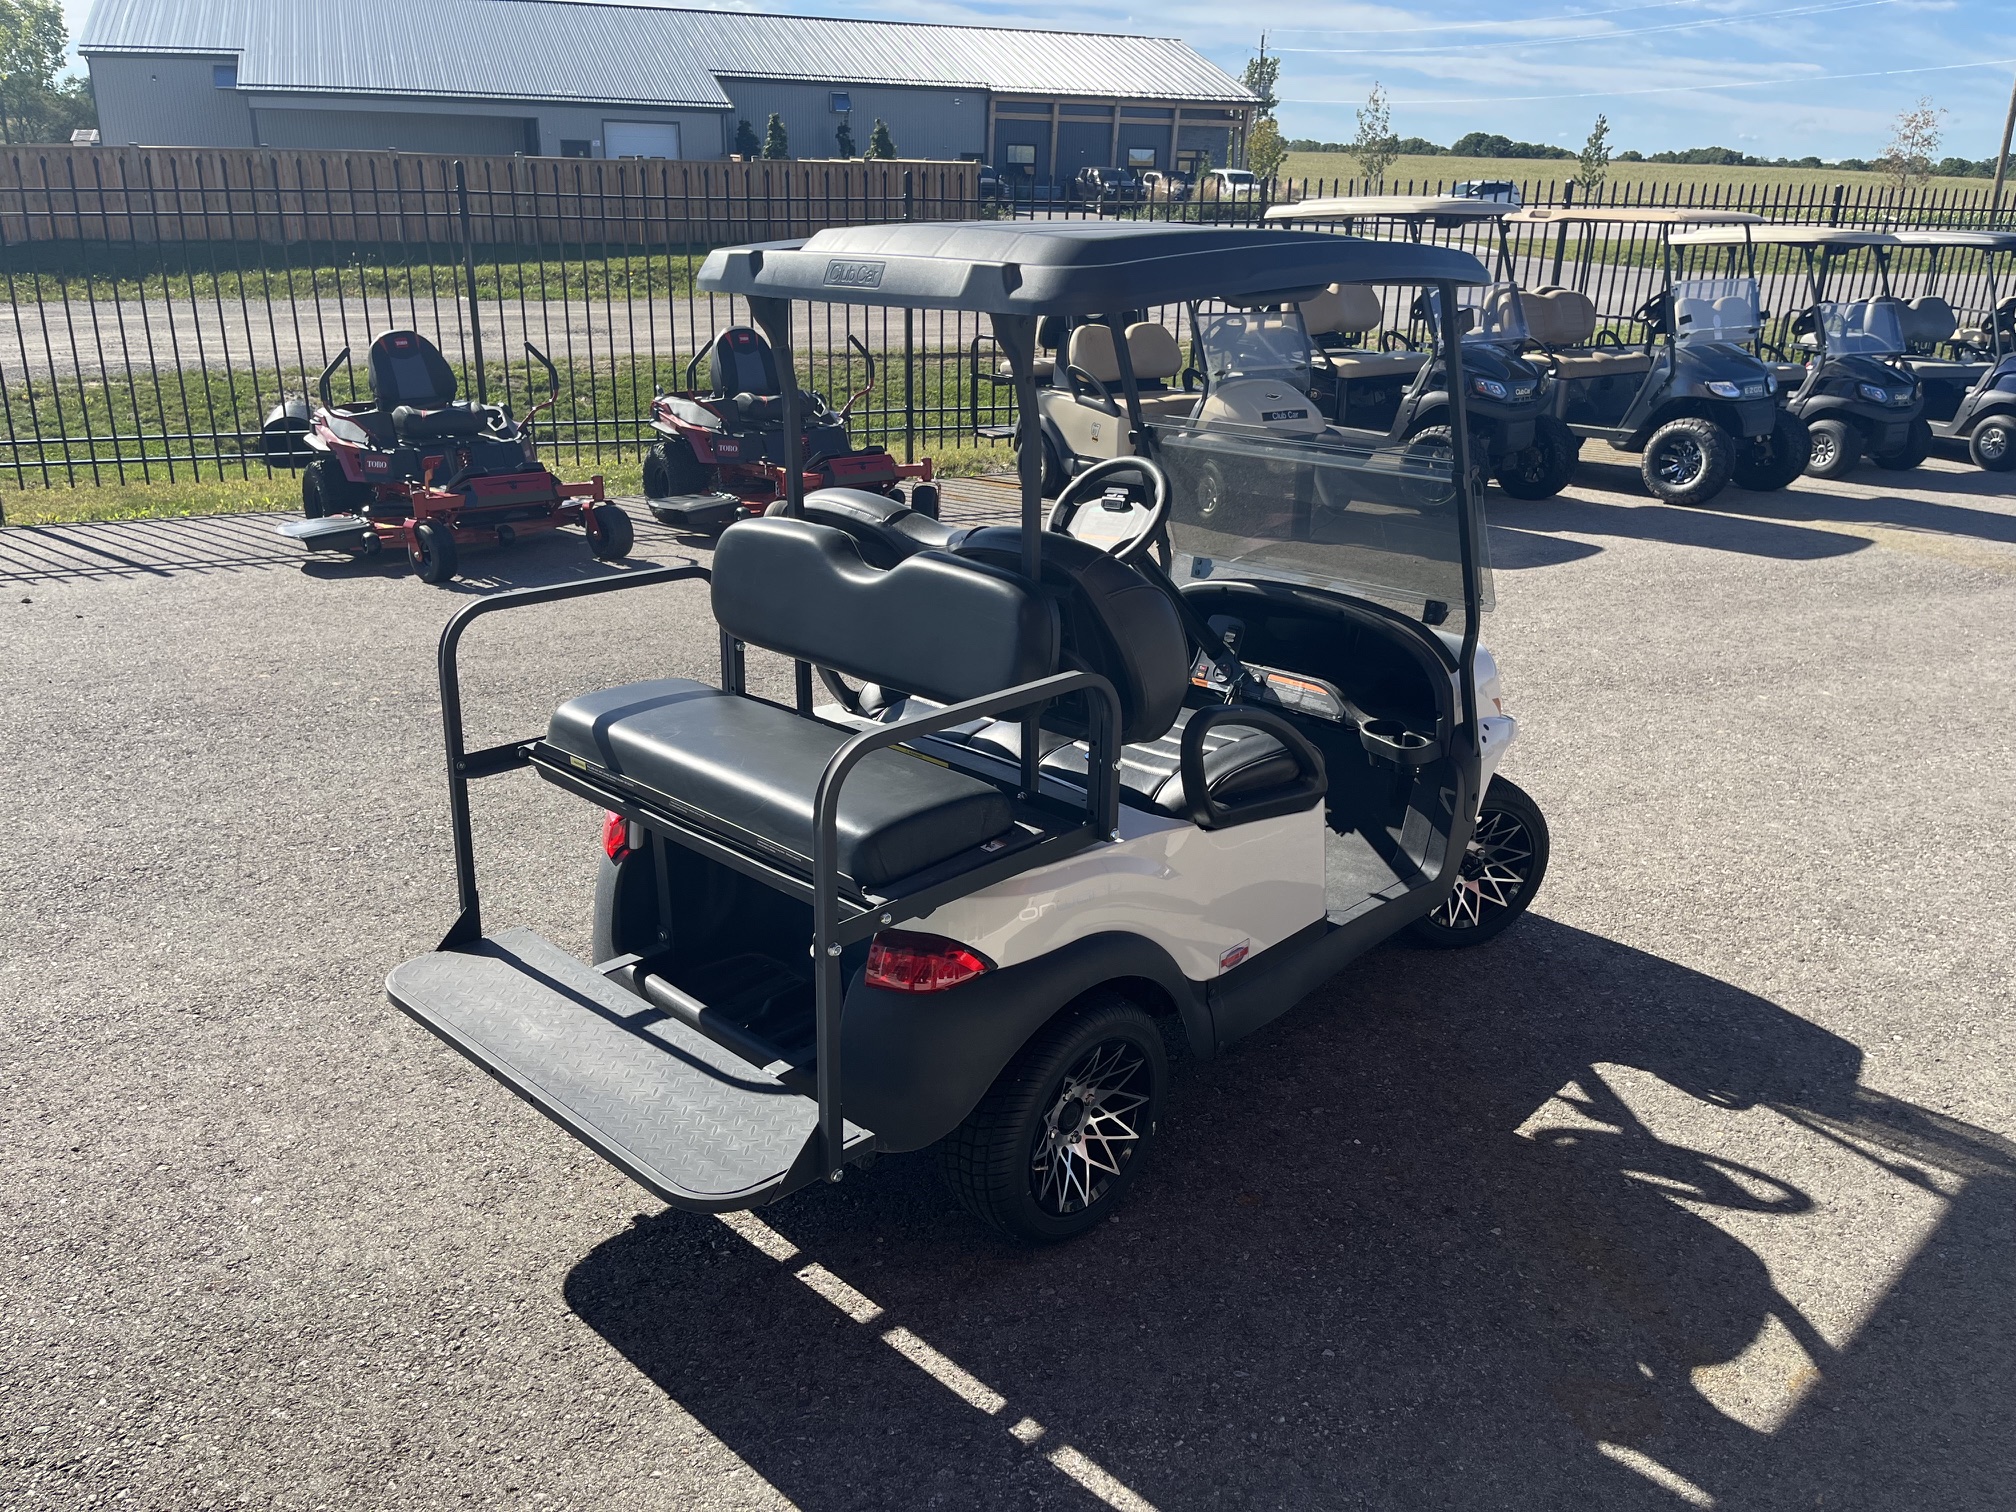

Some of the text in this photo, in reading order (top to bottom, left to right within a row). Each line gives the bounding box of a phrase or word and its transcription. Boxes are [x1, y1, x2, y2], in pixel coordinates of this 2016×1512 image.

[829, 264, 879, 284] Club Car
[1272, 411, 1299, 420] Club Car
[719, 444, 738, 452] TORO
[366, 460, 387, 469] TORO
